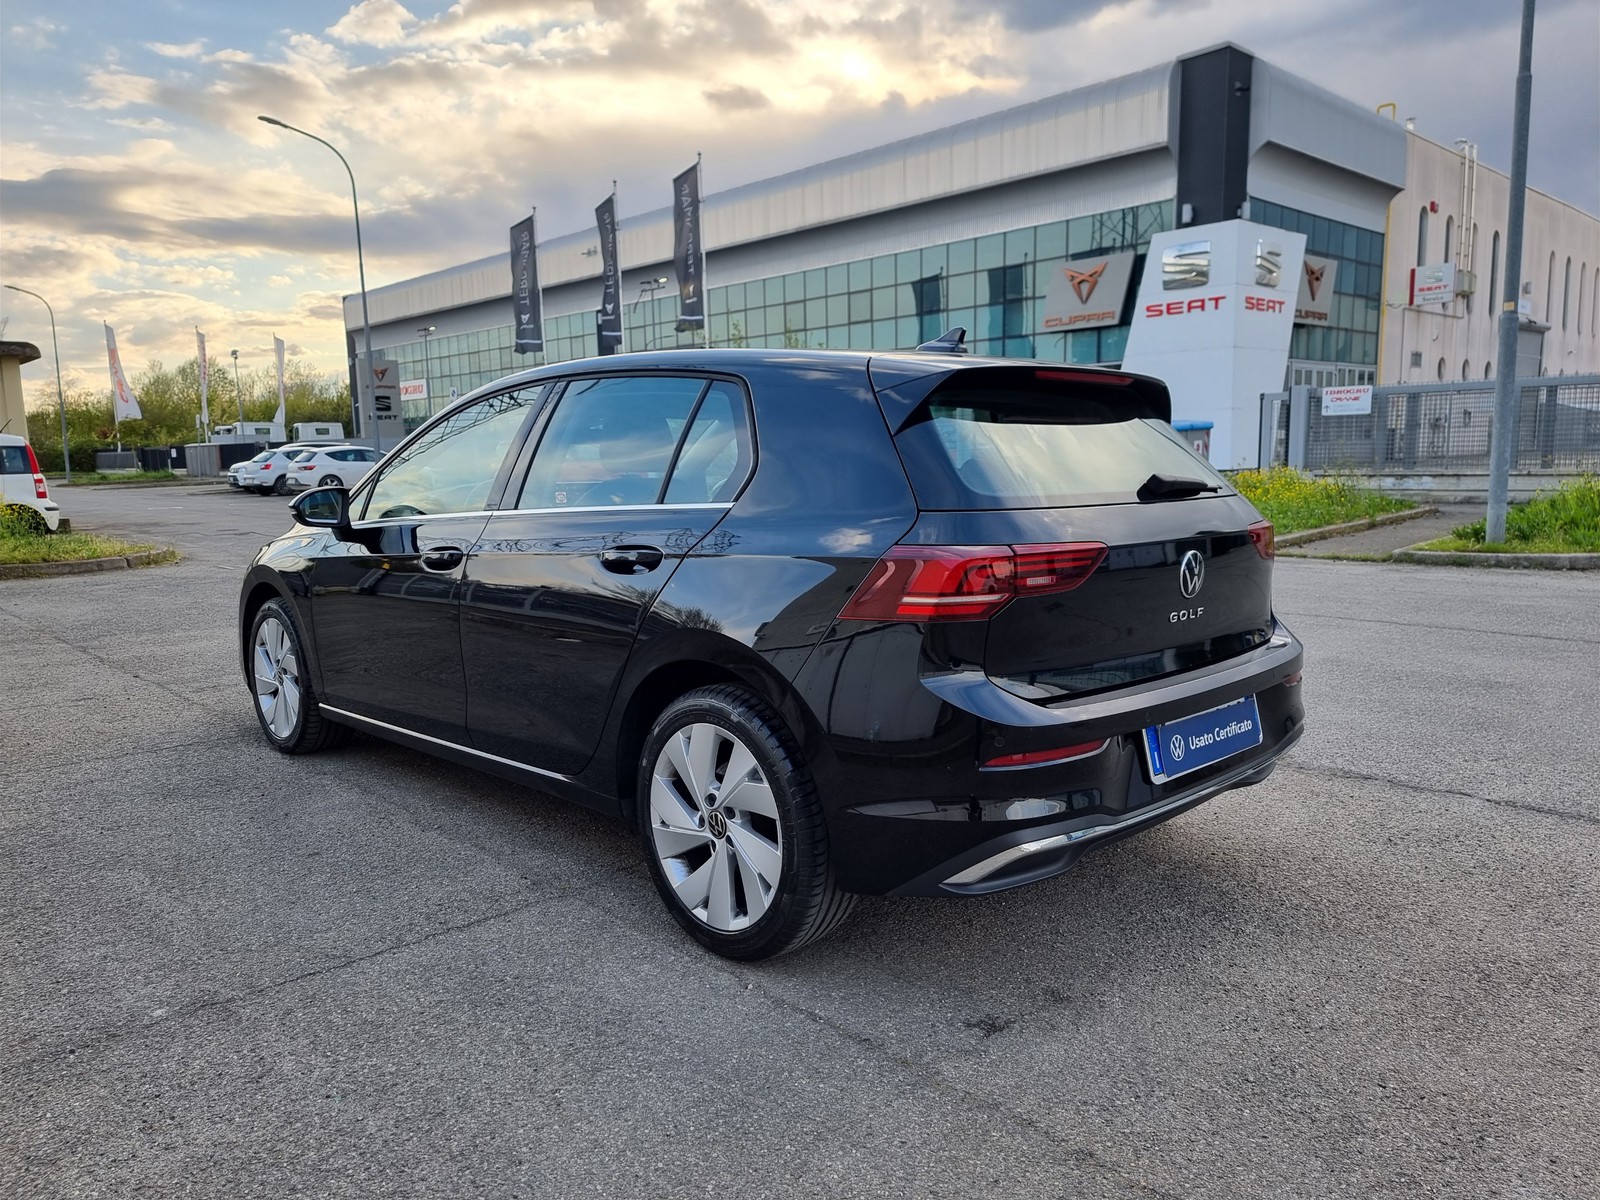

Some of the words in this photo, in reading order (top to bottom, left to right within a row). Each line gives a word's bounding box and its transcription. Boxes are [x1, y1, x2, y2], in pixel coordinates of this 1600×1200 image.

[1418, 284, 1448, 293] SEAT
[1145, 296, 1227, 318] SEAT
[1245, 296, 1285, 314] SEAT
[1044, 310, 1116, 328] CUPRA
[1169, 607, 1205, 623] GOLF
[1189, 733, 1214, 750] Usato
[1214, 719, 1253, 741] Certificato
